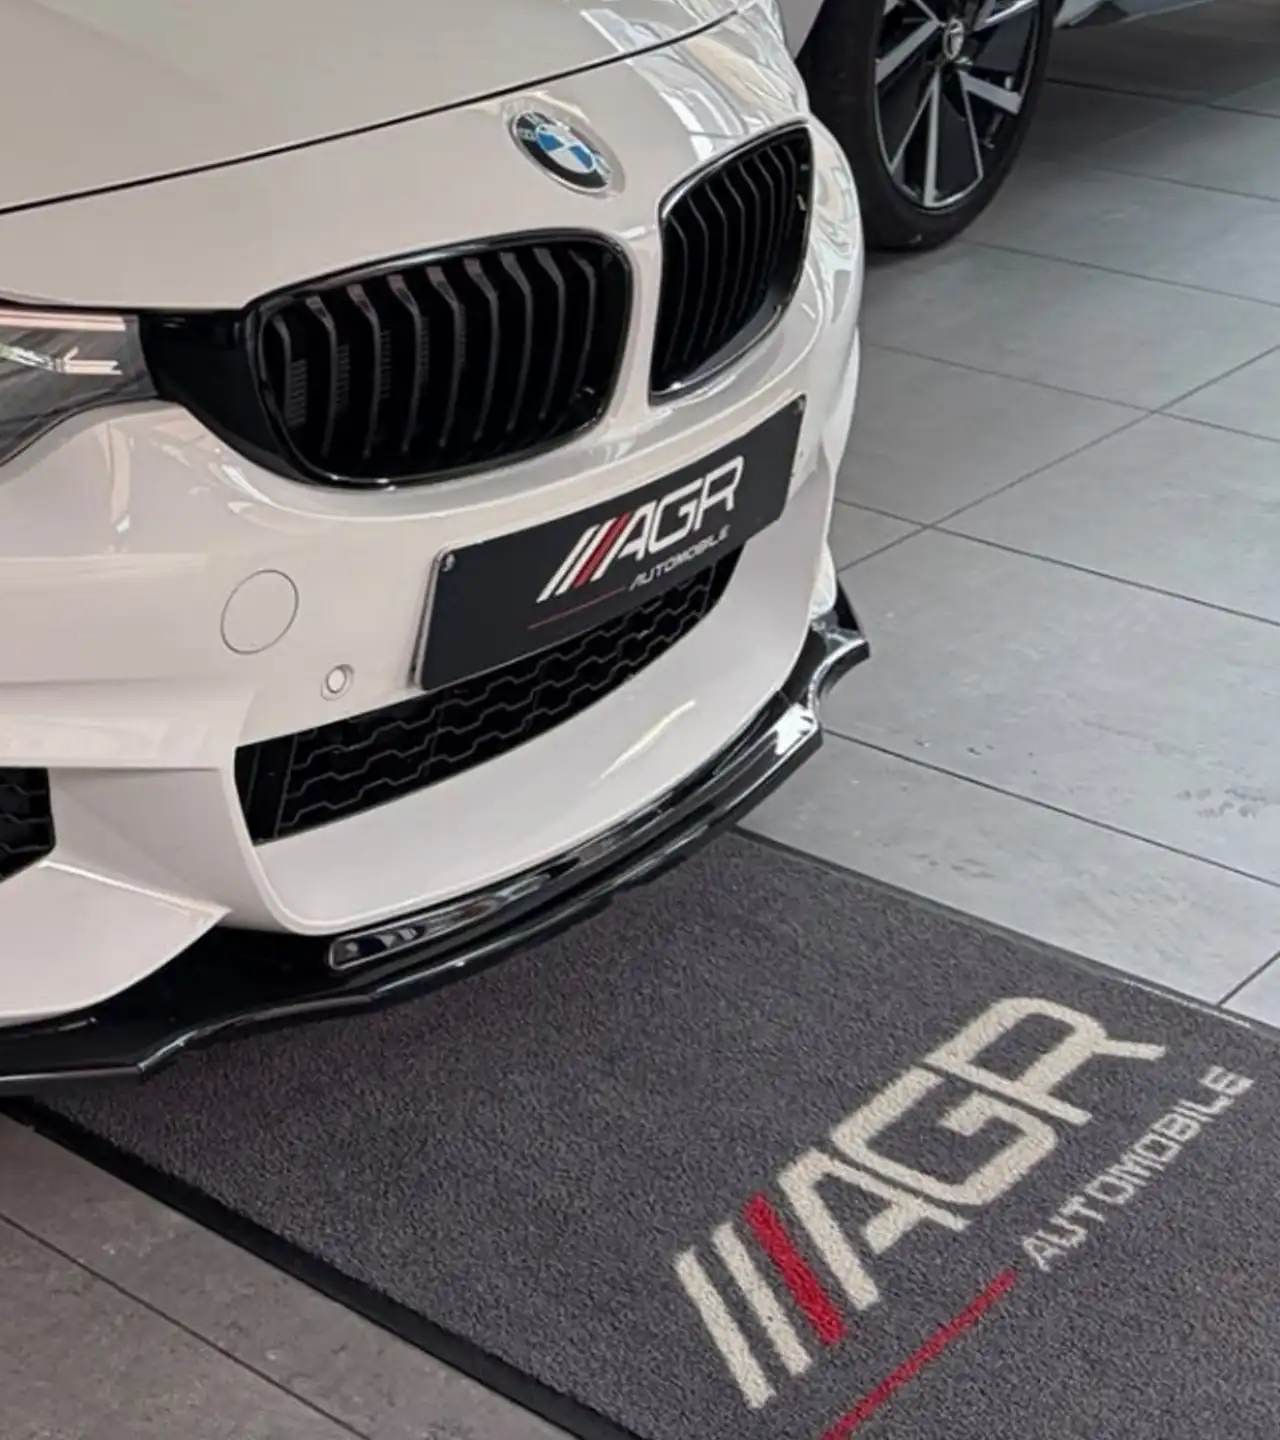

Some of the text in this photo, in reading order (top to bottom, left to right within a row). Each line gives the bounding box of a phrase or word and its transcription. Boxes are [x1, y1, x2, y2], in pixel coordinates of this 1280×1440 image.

[595, 456, 744, 580] AGR
[628, 524, 730, 592] AUTOMOBILE
[777, 997, 1166, 1310] AGR
[1022, 1065, 1255, 1272] AUTOMOBILE
